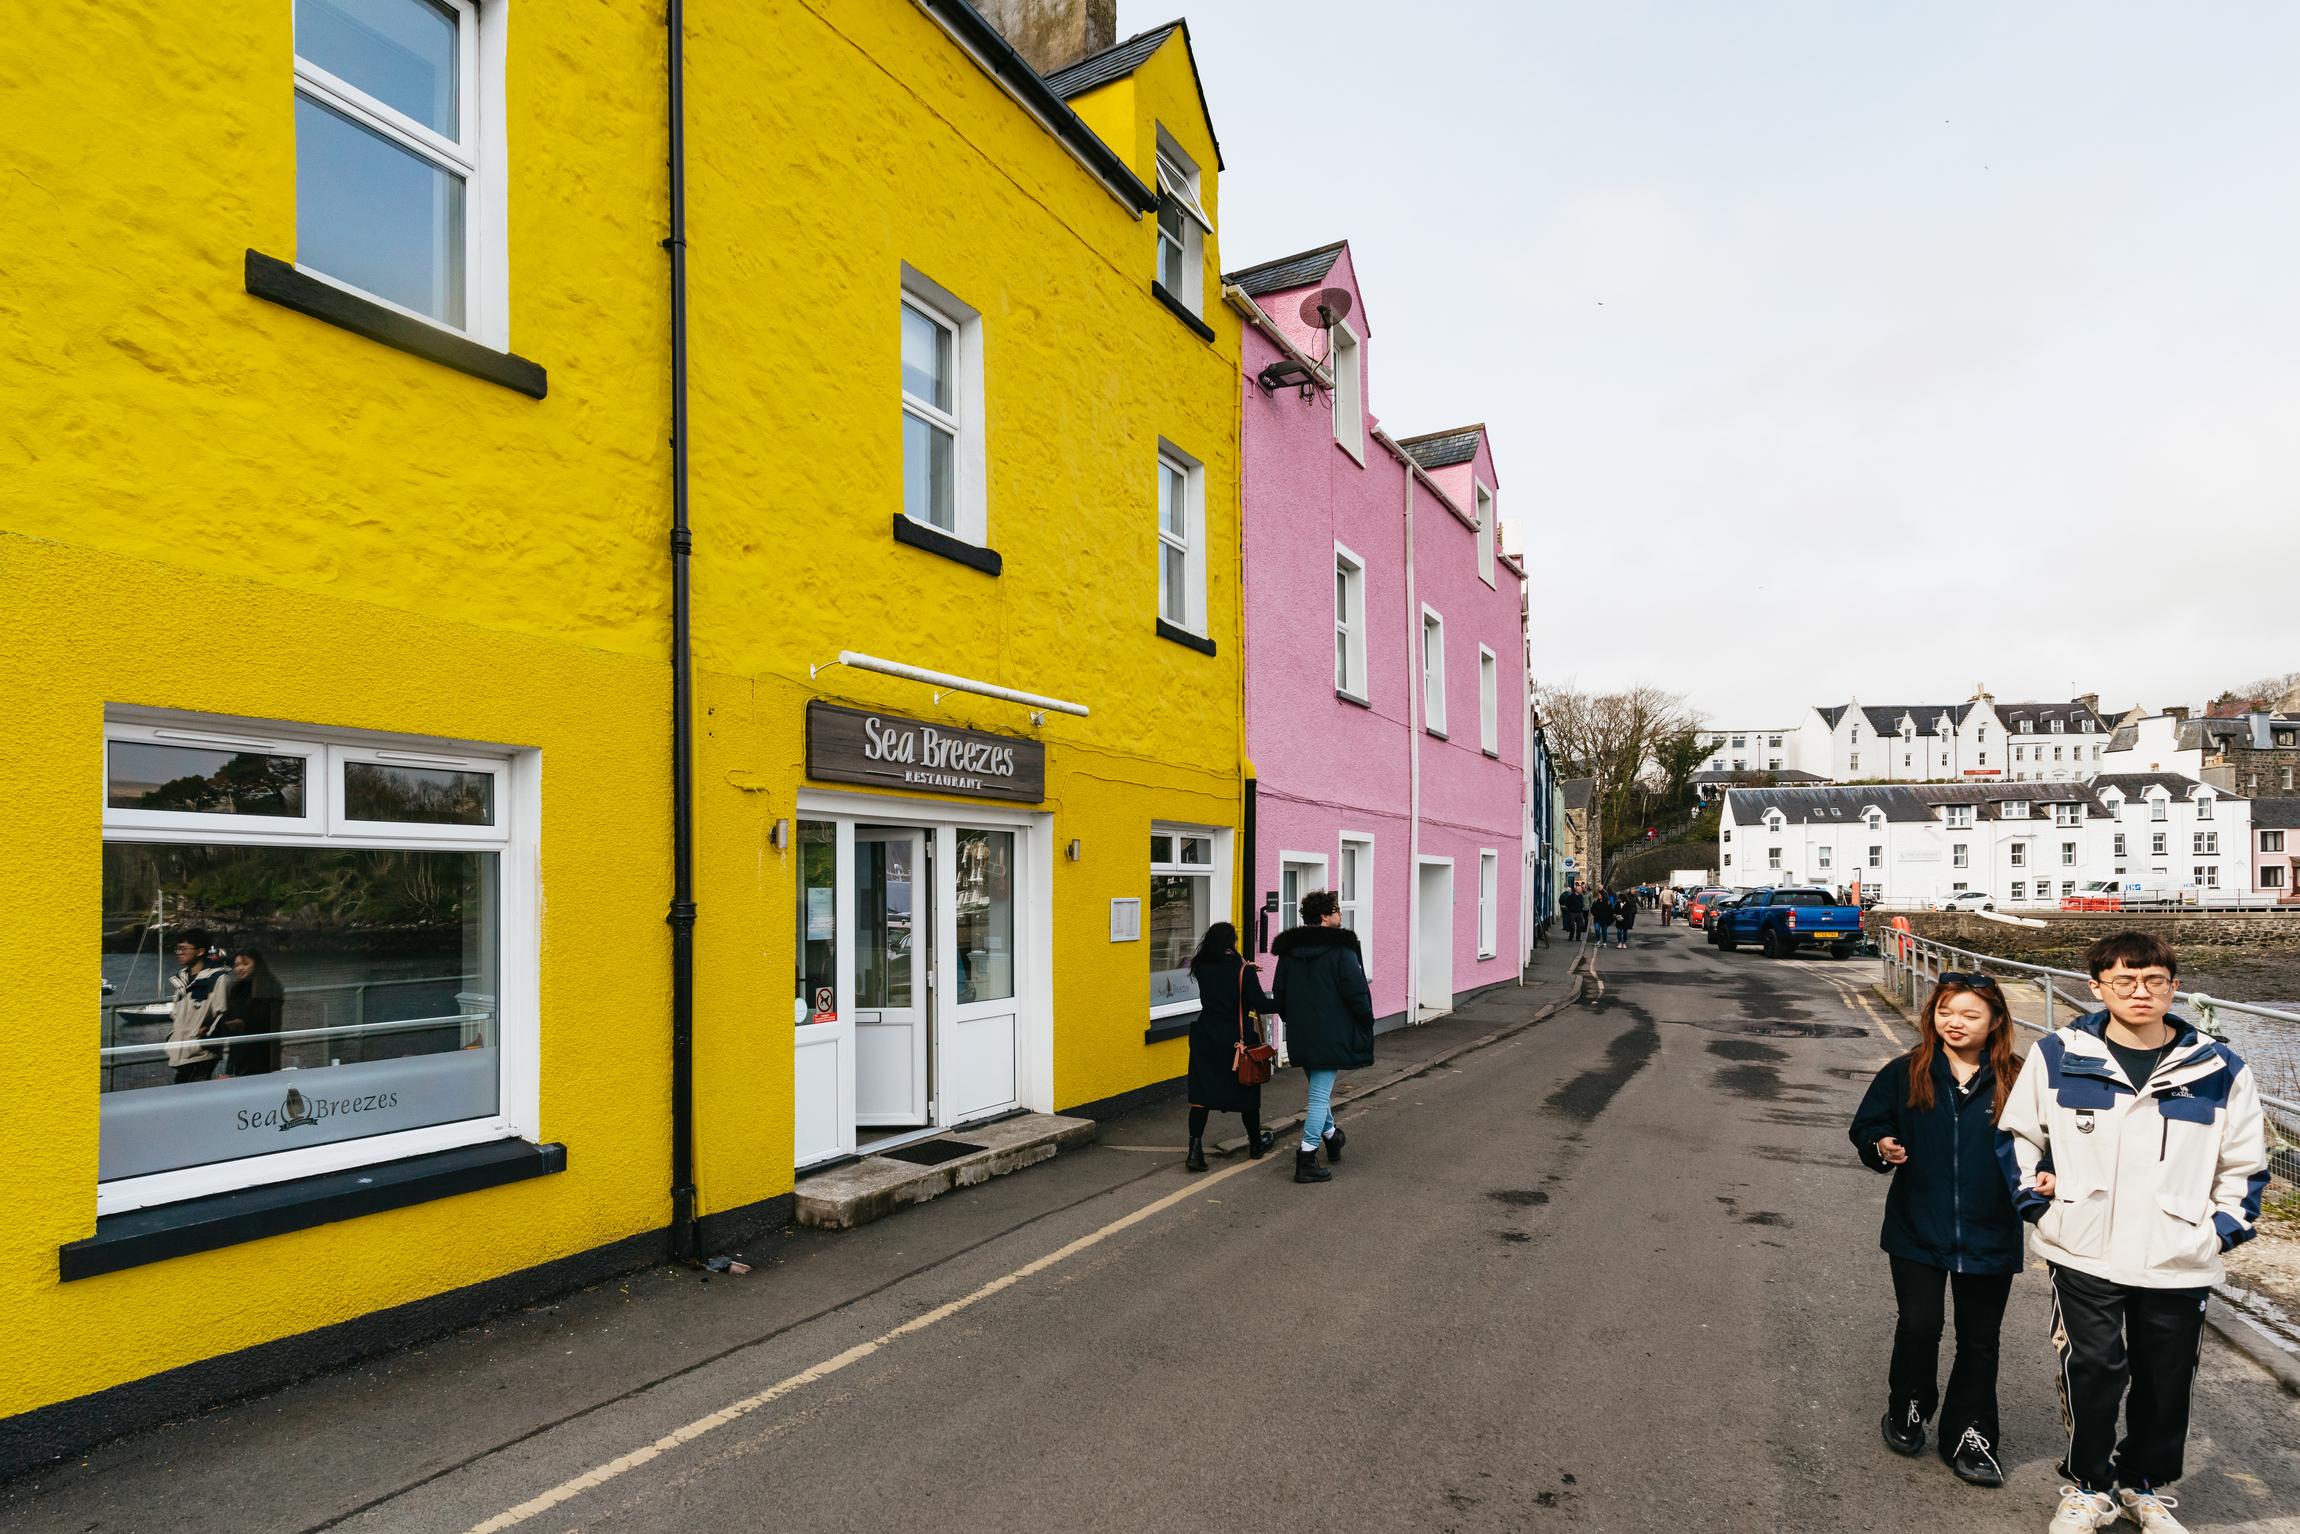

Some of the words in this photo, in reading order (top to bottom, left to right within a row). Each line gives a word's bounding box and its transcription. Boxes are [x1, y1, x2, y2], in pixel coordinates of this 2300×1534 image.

[865, 717, 915, 763] Sea
[920, 727, 1014, 776] Breezes
[905, 771, 982, 789] RESTAURANT
[236, 1109, 278, 1131] Sea
[315, 1091, 398, 1119] Breezes
